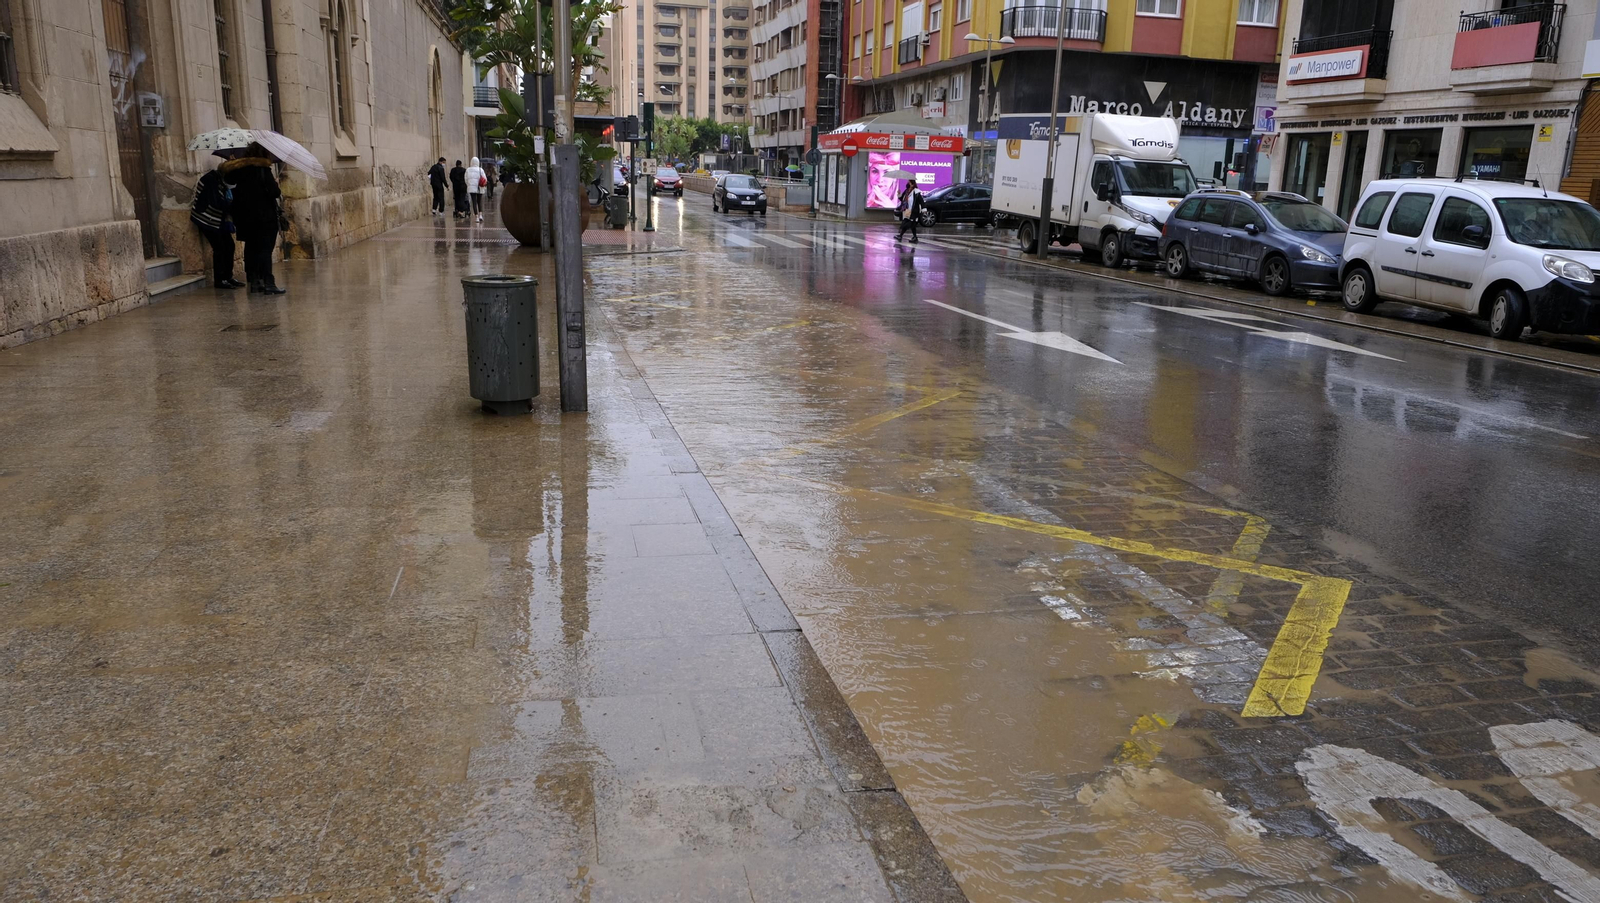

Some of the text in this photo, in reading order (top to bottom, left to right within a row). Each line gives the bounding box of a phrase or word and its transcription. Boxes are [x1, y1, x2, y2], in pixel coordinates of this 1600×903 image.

[1307, 59, 1356, 74] Manpower
[1070, 95, 1247, 128] Marco Aldany
[1356, 118, 1368, 126] LUIS
[1403, 113, 1459, 124] INSTRUMENTOS
[1462, 111, 1506, 121] MUSICALES
[1512, 110, 1529, 120] LUIS
[1533, 108, 1570, 118] GAZQUEZ
[1128, 137, 1174, 149] Tamdis
[1477, 165, 1501, 173] YAMAHA
